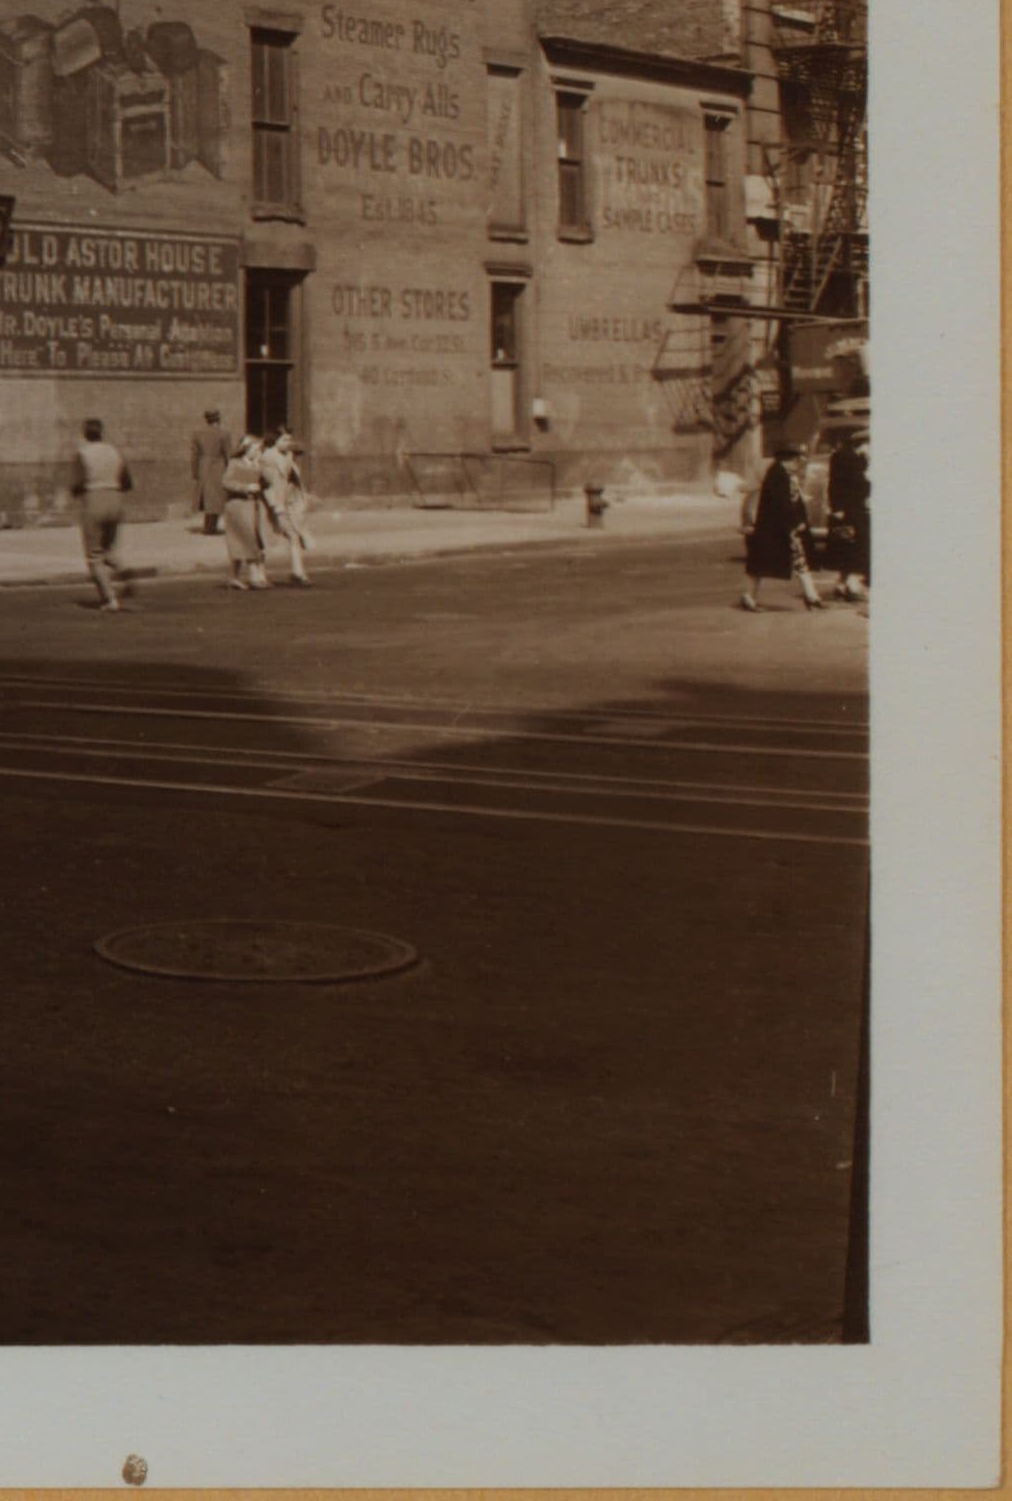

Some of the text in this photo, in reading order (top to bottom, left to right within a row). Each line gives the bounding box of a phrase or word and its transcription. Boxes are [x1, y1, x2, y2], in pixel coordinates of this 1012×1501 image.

[321, 4, 460, 70] Steamer Rugs
[317, 126, 396, 173] DOYLE
[65, 237, 139, 271] ASTOR
[145, 242, 223, 276] HOUSE
[73, 276, 237, 311] MANUFACTURER
[331, 285, 470, 322] OTHER STORES
[23, 311, 94, 340] DOYLE'S
